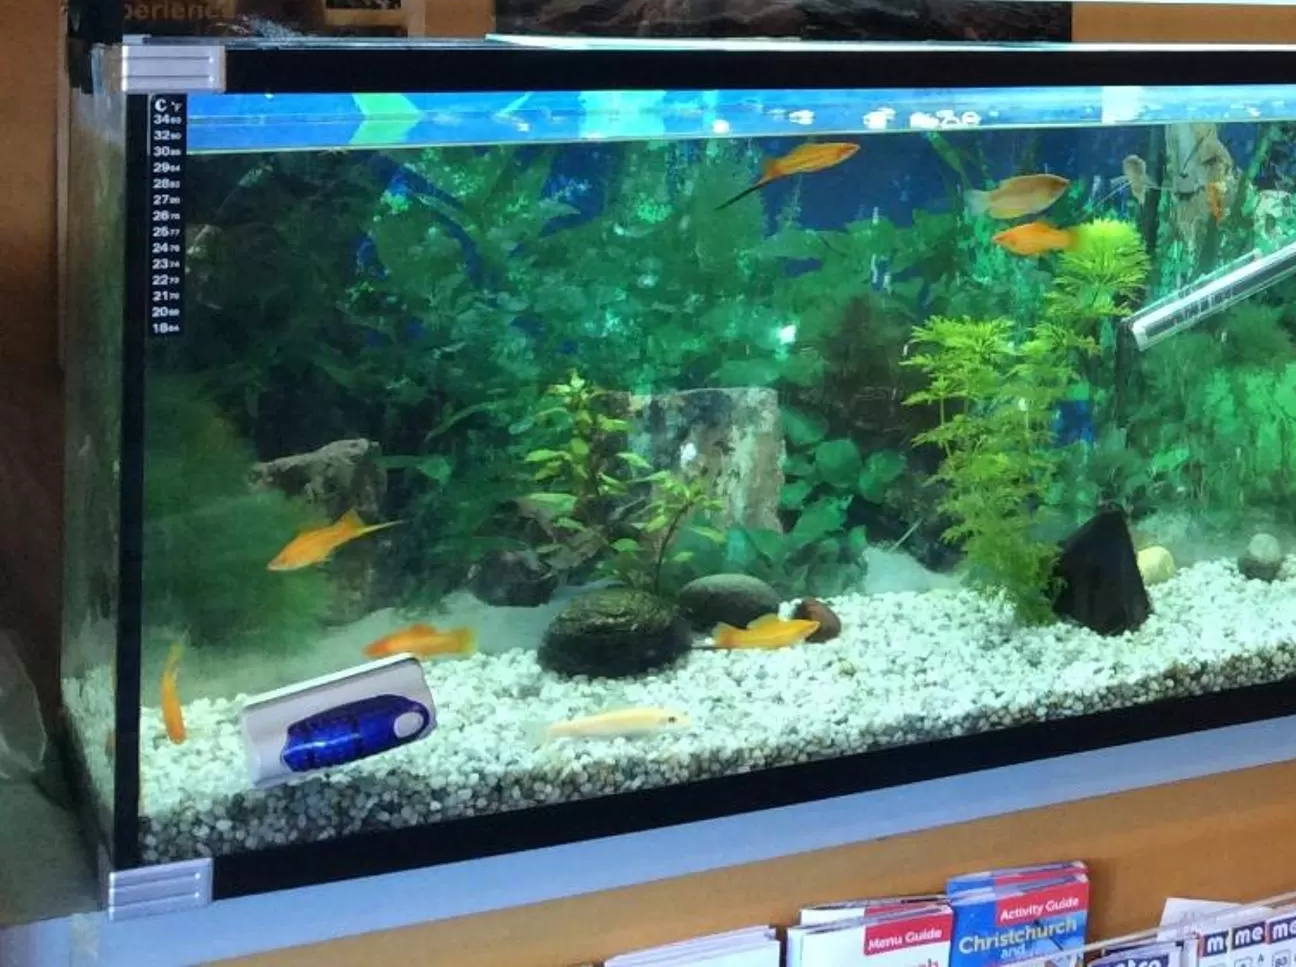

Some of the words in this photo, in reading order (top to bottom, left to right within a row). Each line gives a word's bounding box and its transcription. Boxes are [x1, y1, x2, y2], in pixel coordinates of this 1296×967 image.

[153, 114, 170, 124] 34
[153, 130, 170, 140] 32
[153, 146, 170, 157] 30
[153, 162, 169, 173] 29
[153, 178, 169, 189] 28
[152, 194, 169, 205] 27
[152, 210, 169, 221] 26
[152, 242, 169, 253] 24
[152, 258, 169, 269] 23
[152, 274, 169, 285] 22
[152, 291, 169, 301] 21
[152, 306, 169, 317] 20
[152, 322, 169, 334] 18
[1000, 903, 1043, 922] Activity
[1046, 896, 1079, 913] Guide
[868, 937, 903, 951] Menu
[905, 927, 942, 943] Guide
[958, 917, 1077, 954] Christchurch
[1001, 944, 1026, 959] and
